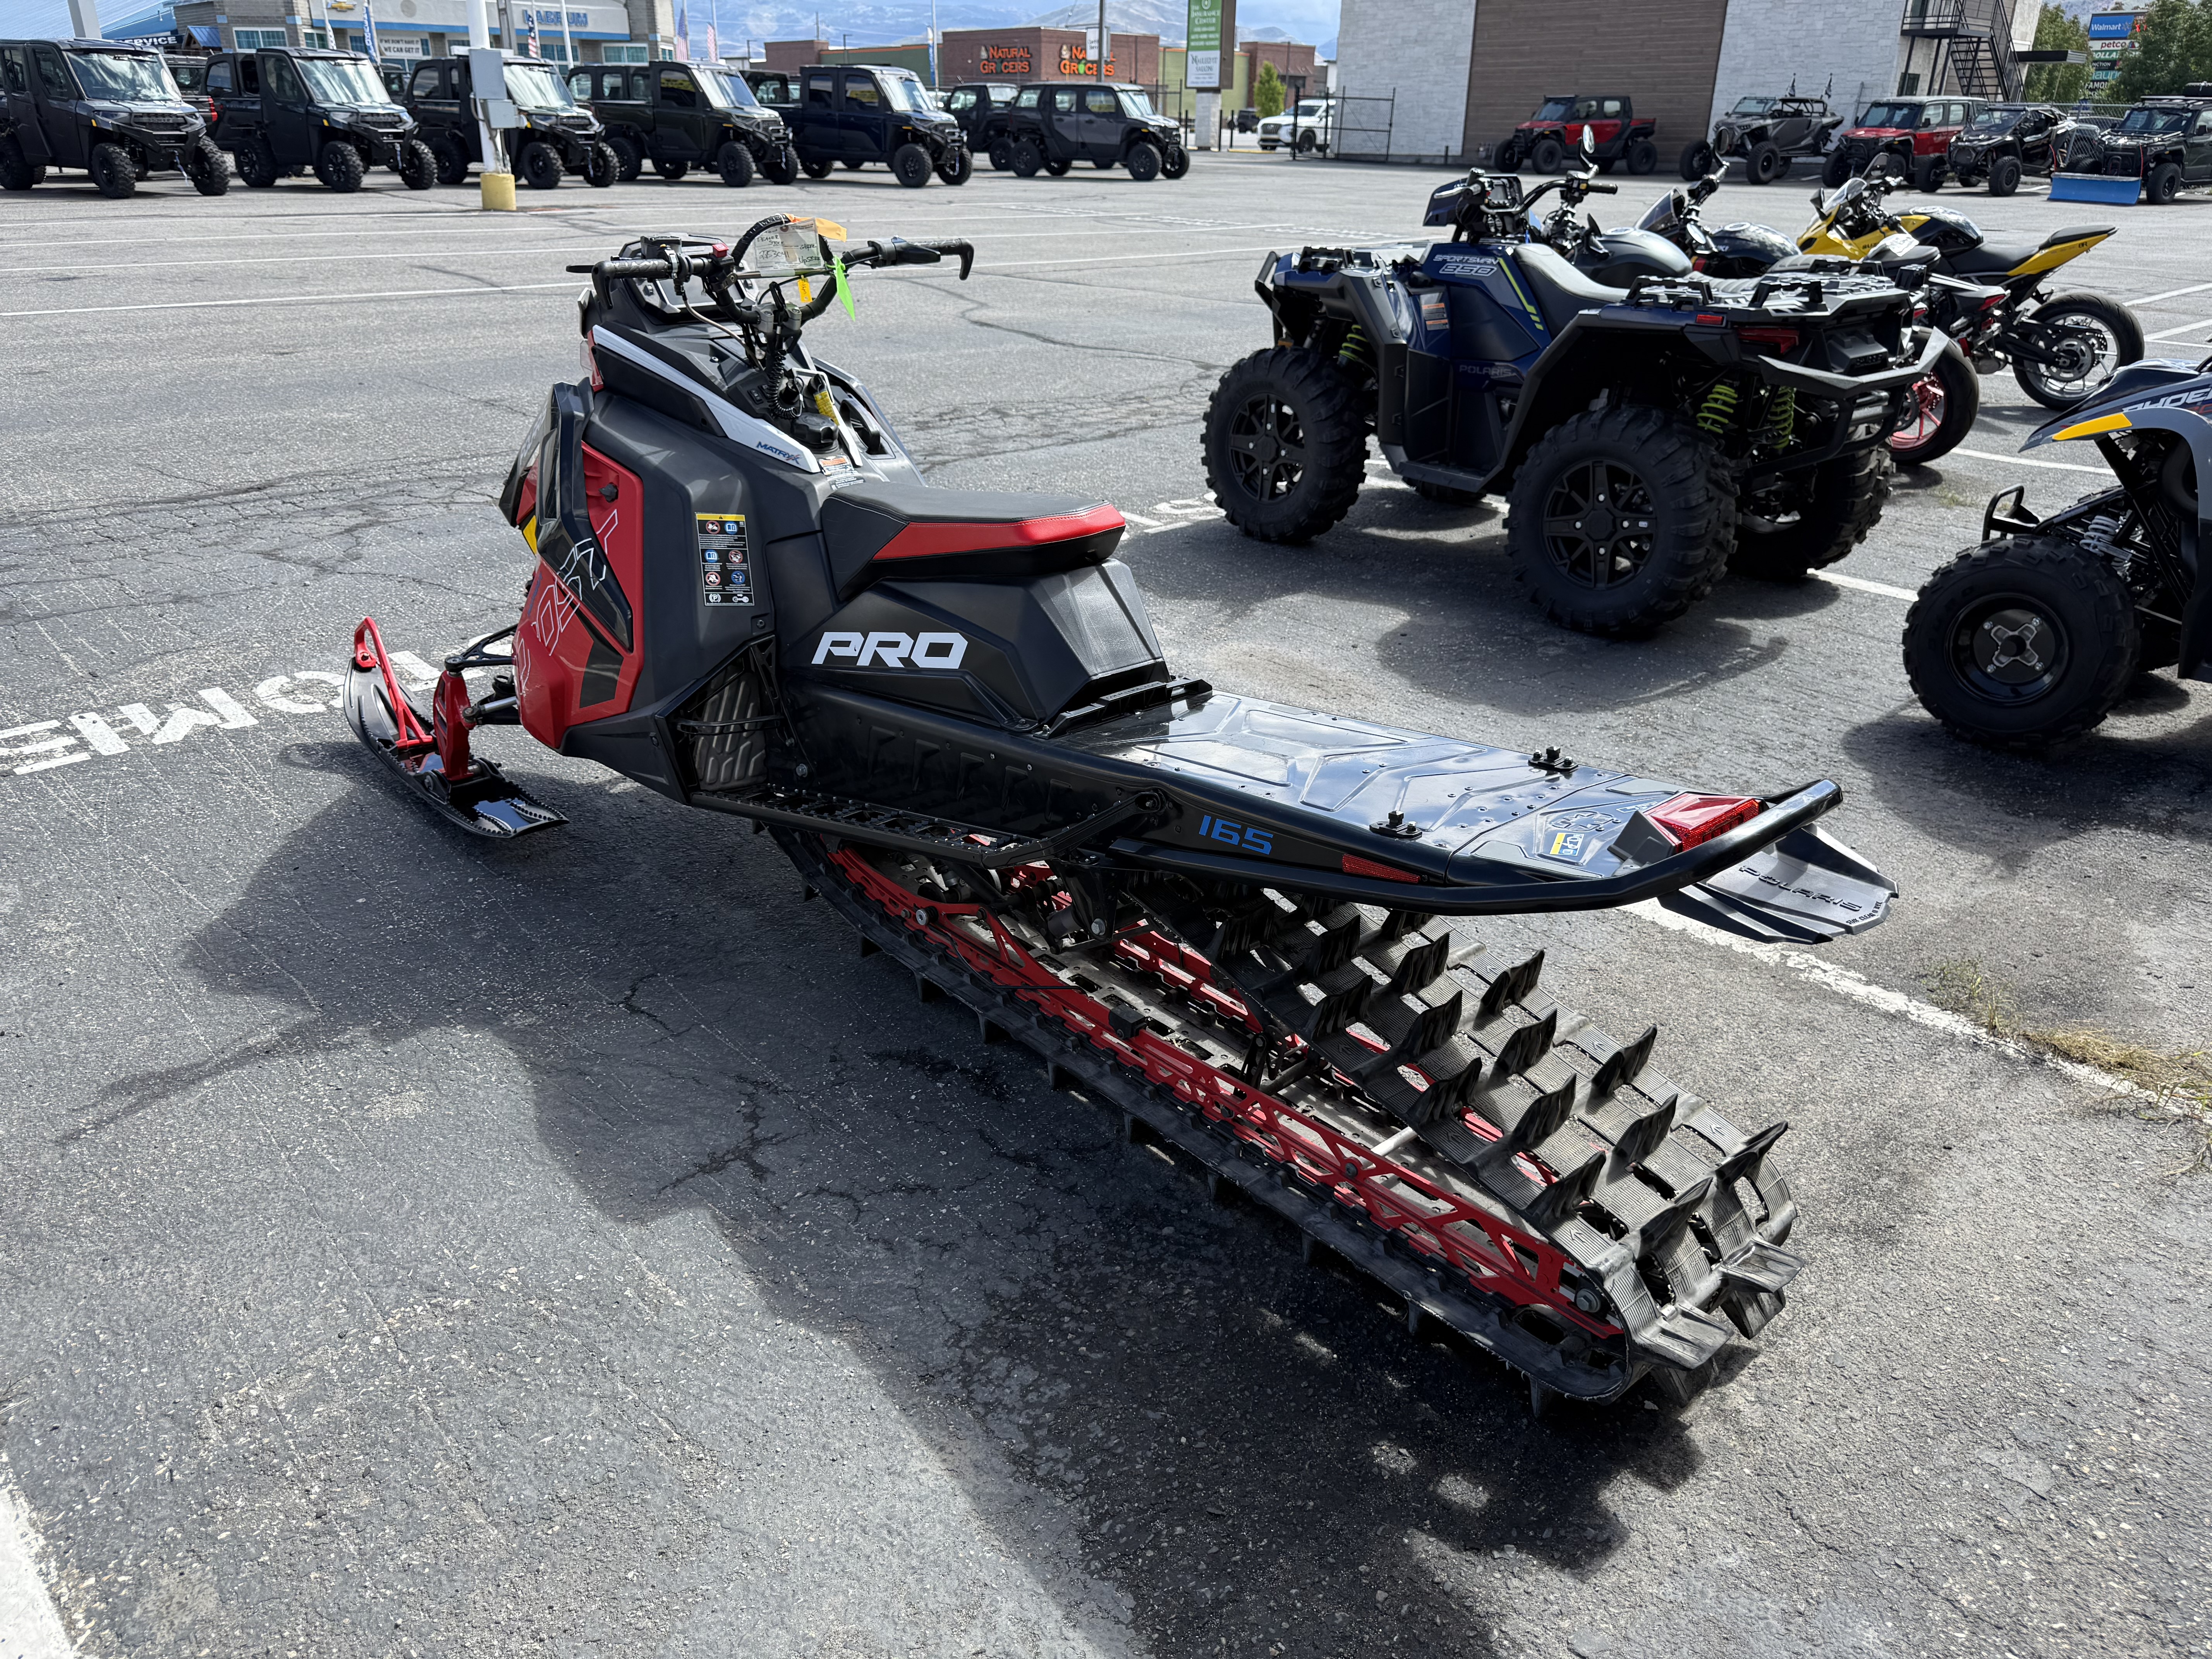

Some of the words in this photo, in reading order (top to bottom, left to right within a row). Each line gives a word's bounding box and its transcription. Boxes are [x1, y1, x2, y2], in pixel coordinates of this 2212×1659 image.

[2100, 41, 2127, 50] petco
[989, 46, 1031, 59] NATURAL
[1433, 254, 1499, 265] SPORTSMAN
[1439, 263, 1497, 276] 850
[1459, 365, 1511, 376] POLARIS
[756, 441, 802, 465] MATRYX
[811, 632, 969, 669] PRO
[1199, 815, 1273, 855] 165
[1738, 865, 1863, 912] POLARIS
